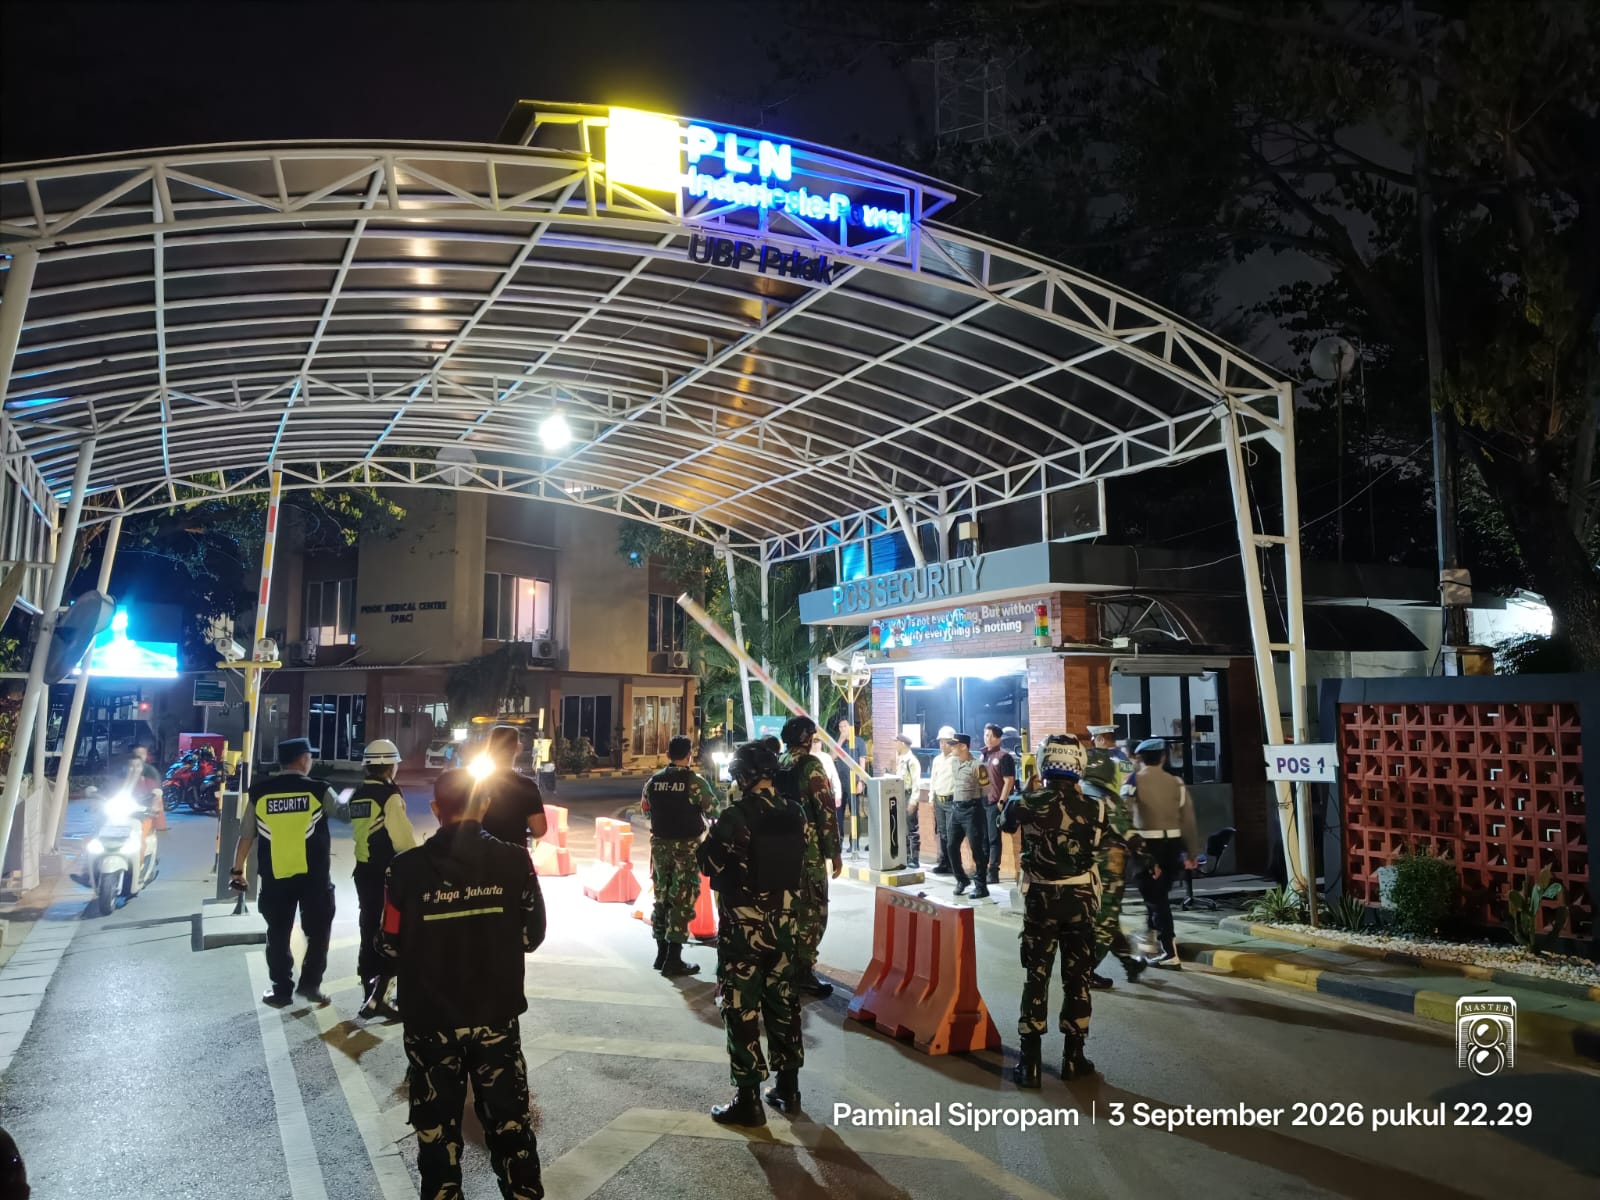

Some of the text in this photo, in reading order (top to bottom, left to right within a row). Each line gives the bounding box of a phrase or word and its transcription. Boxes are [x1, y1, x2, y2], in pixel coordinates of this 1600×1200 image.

[687, 124, 793, 182] PLN
[688, 232, 754, 268] UBP
[832, 555, 985, 615] POS SECURITY
[917, 614, 930, 627] not
[981, 604, 1000, 619] But
[1002, 600, 1040, 617] withou
[972, 623, 981, 634] is
[984, 618, 1022, 634] nothing
[1276, 756, 1325, 774] POS 1
[654, 782, 686, 791] TNI-AD
[267, 797, 308, 813] SECURITY
[423, 885, 504, 904] # Jaga Jakarta
